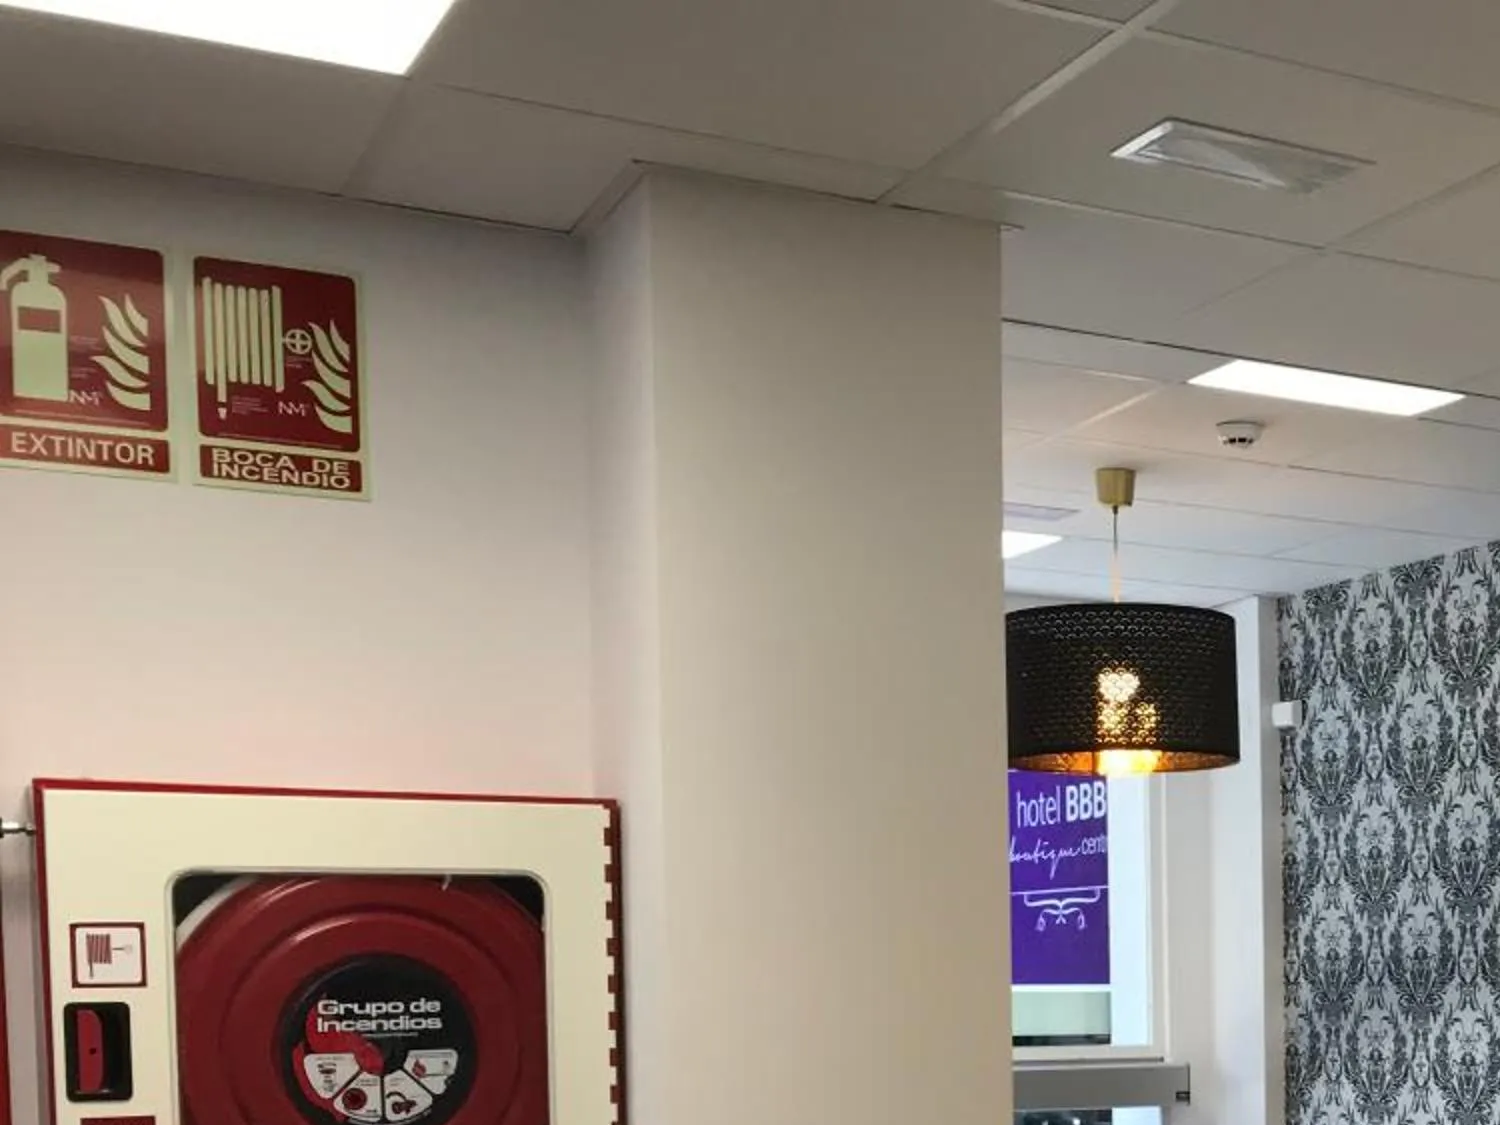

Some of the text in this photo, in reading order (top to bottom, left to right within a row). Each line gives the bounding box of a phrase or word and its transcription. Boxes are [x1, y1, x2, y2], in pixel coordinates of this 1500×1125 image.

[11, 431, 155, 466] EXTINTOR
[211, 447, 349, 476] BOCA DE
[212, 461, 350, 489] INCENDIO
[1016, 781, 1107, 828] hotel BBB
[316, 997, 442, 1017] Grupo de
[316, 1014, 443, 1033] Incendios
